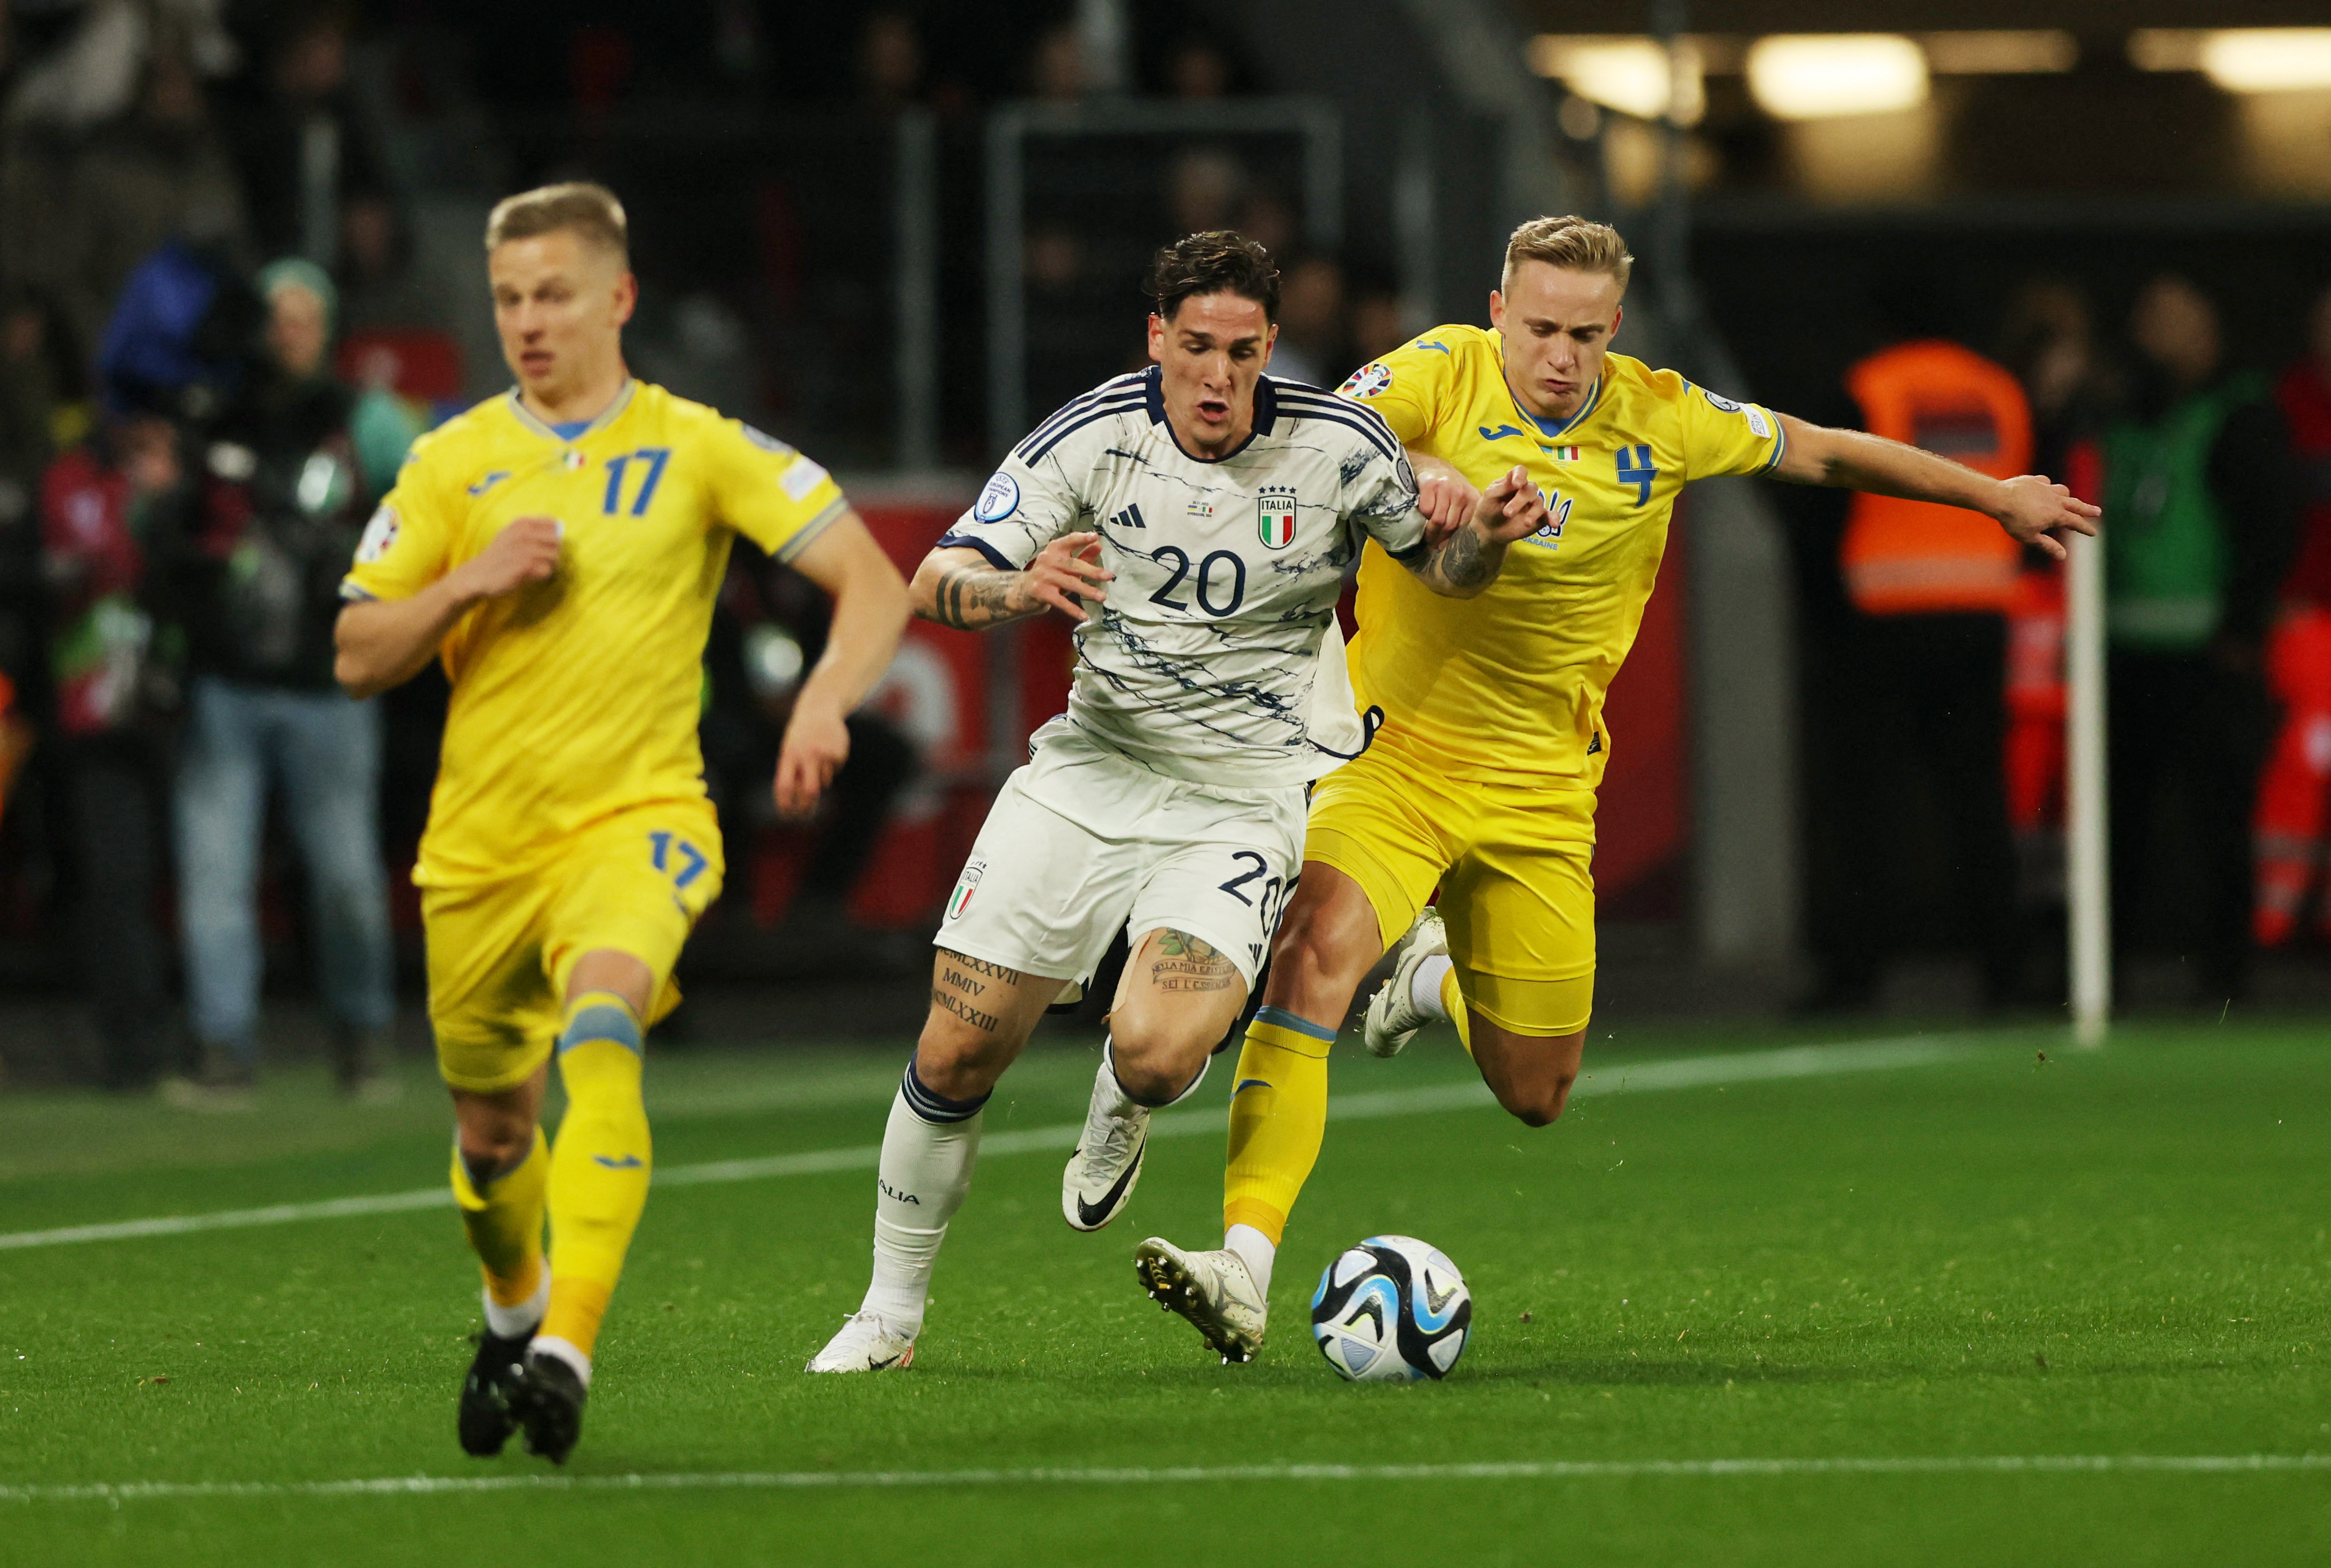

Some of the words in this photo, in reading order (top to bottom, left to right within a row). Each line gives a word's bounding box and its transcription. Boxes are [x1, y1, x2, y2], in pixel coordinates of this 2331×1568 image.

[604, 449, 669, 515] 17
[990, 482, 1012, 493] EUROPEAN
[1614, 444, 1659, 509] 4
[987, 487, 1008, 497] CHAMPIONS
[1261, 500, 1292, 510] ITALIA
[1148, 546, 1246, 617] 20
[650, 831, 707, 888] 17
[962, 871, 979, 884] ITALIA
[1217, 850, 1281, 940] 20
[1180, 962, 1196, 972] MIA
[943, 968, 985, 996] MMIV
[1163, 979, 1177, 989] SEI
[934, 990, 999, 1032] CMLXXIII
